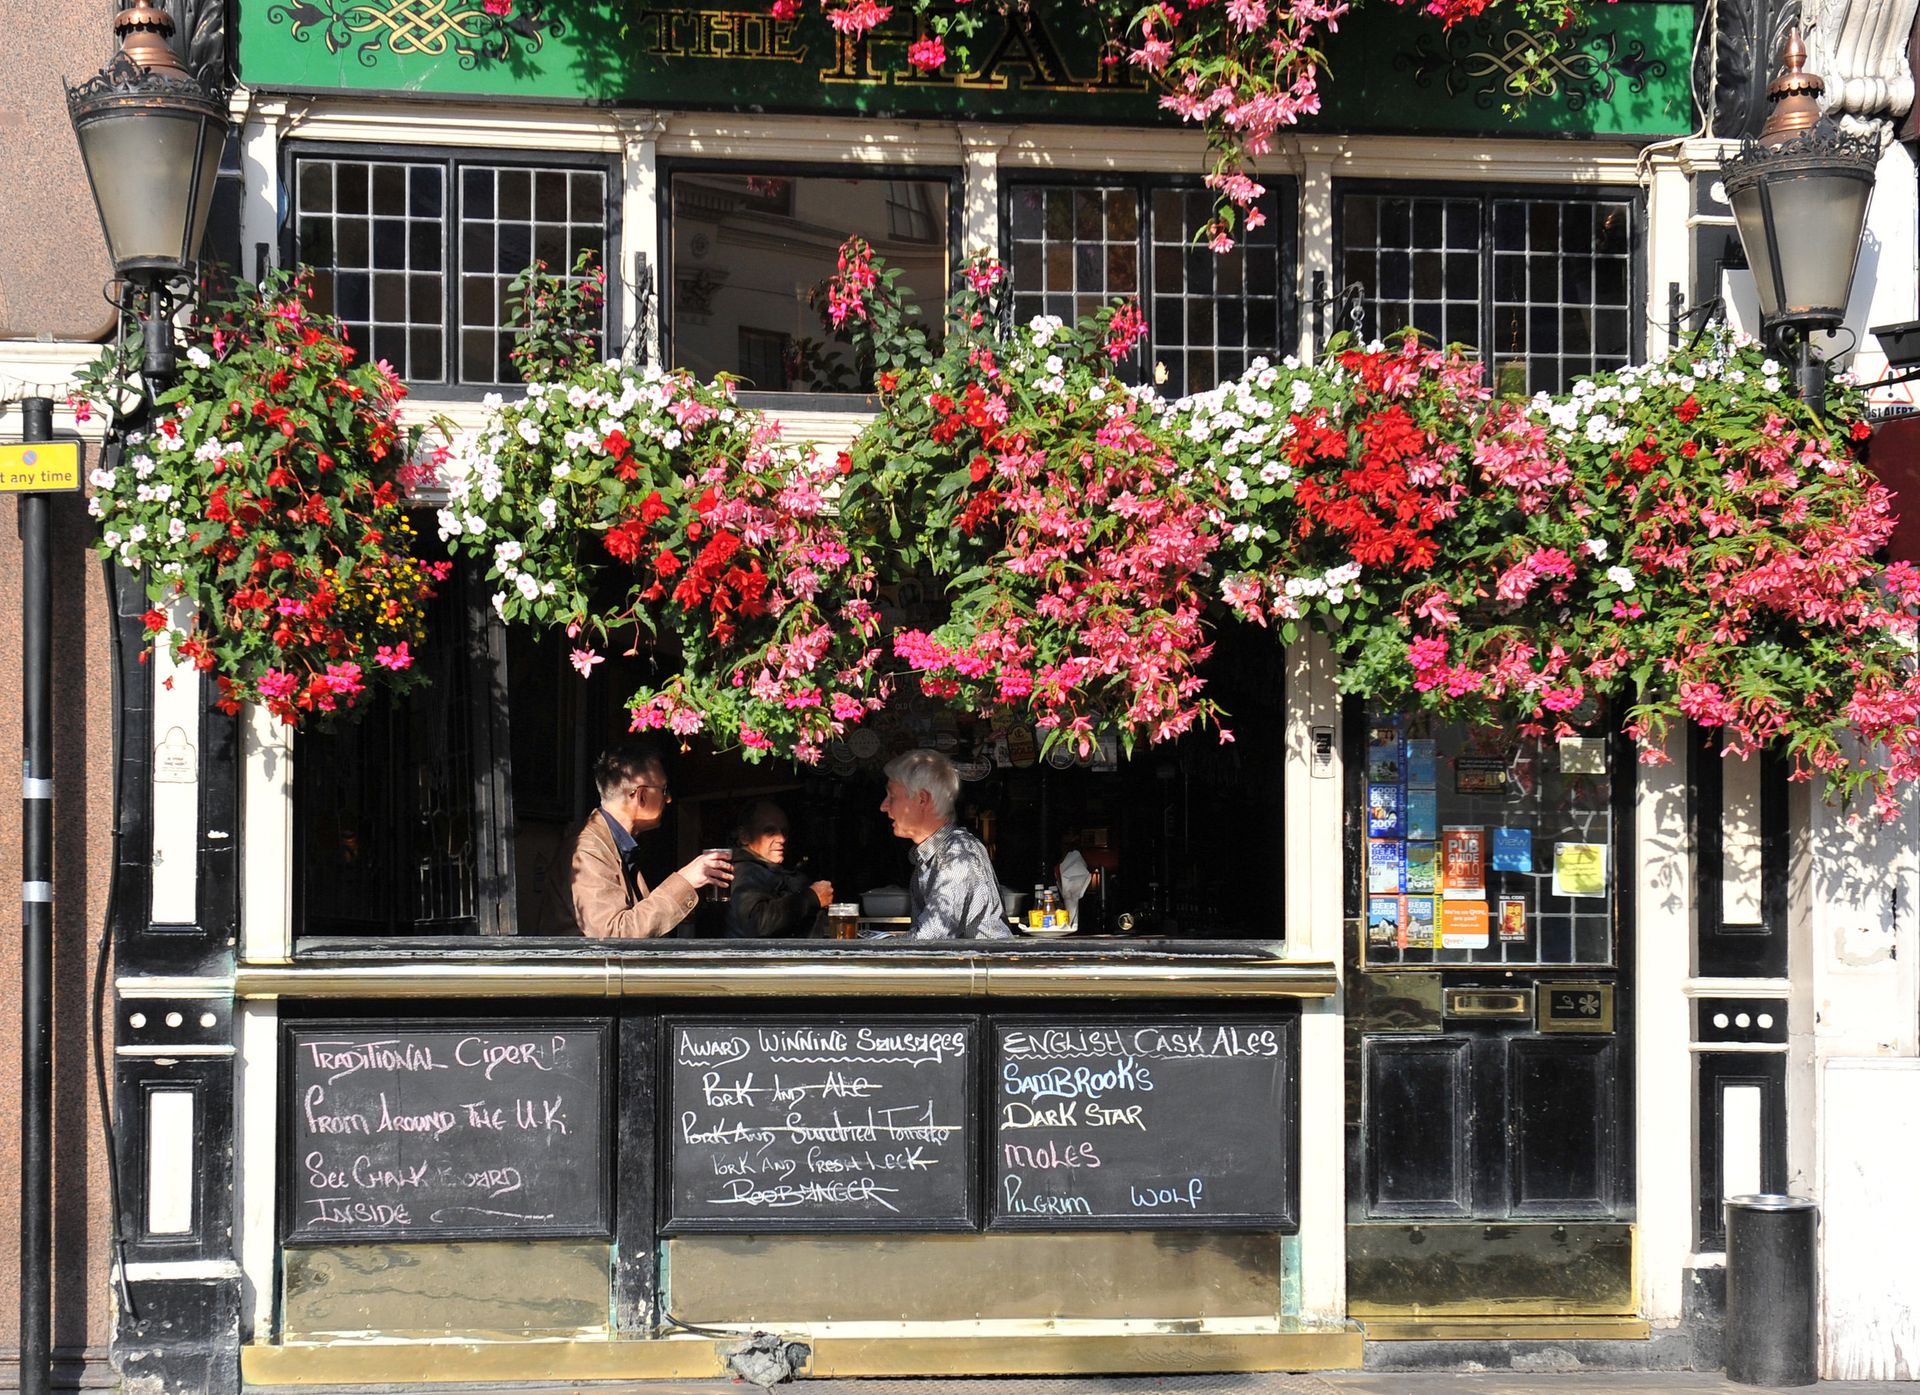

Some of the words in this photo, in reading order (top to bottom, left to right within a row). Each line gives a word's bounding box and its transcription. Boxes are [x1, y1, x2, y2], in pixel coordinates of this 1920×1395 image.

[640, 8, 809, 63] THE
[11, 473, 35, 484] any
[41, 471, 72, 482] time
[1371, 819, 1397, 829] 2007
[1447, 853, 1480, 863] GUIDE
[1448, 839, 1480, 852] PUB
[1447, 862, 1480, 876] 2010
[1371, 902, 1397, 910] BEER
[1407, 901, 1432, 909] BEER
[678, 1031, 750, 1068] AWARD
[758, 1029, 847, 1053] WINNING
[856, 1028, 965, 1062] SAUSAGES
[1003, 1029, 1126, 1056] ENGLISH
[1134, 1027, 1203, 1053] CASK
[1212, 1026, 1278, 1056] ALES
[455, 1036, 552, 1080] CIDER
[703, 1072, 755, 1107] PORK
[772, 1074, 805, 1110] AND
[822, 1071, 871, 1098] ALE
[1004, 1056, 1153, 1103] SAMBROOK'S
[304, 1085, 369, 1135] FROM
[376, 1092, 457, 1141] AROUND
[460, 1101, 506, 1131] THE
[1000, 1101, 1077, 1131] DARK
[1085, 1102, 1146, 1131] STAR
[682, 1111, 731, 1144] PORK
[734, 1122, 776, 1156] AND
[711, 1151, 756, 1176] PORK
[762, 1157, 797, 1181] AND
[807, 1146, 863, 1174] FRESH
[865, 1146, 928, 1171] LEEK
[1004, 1140, 1101, 1168] MOLES
[305, 1151, 349, 1189] SEE
[353, 1155, 428, 1194] CHALK
[1004, 1174, 1093, 1215] PILGRIM
[1131, 1178, 1203, 1209] WOLF
[304, 1197, 411, 1228] INSIDE
